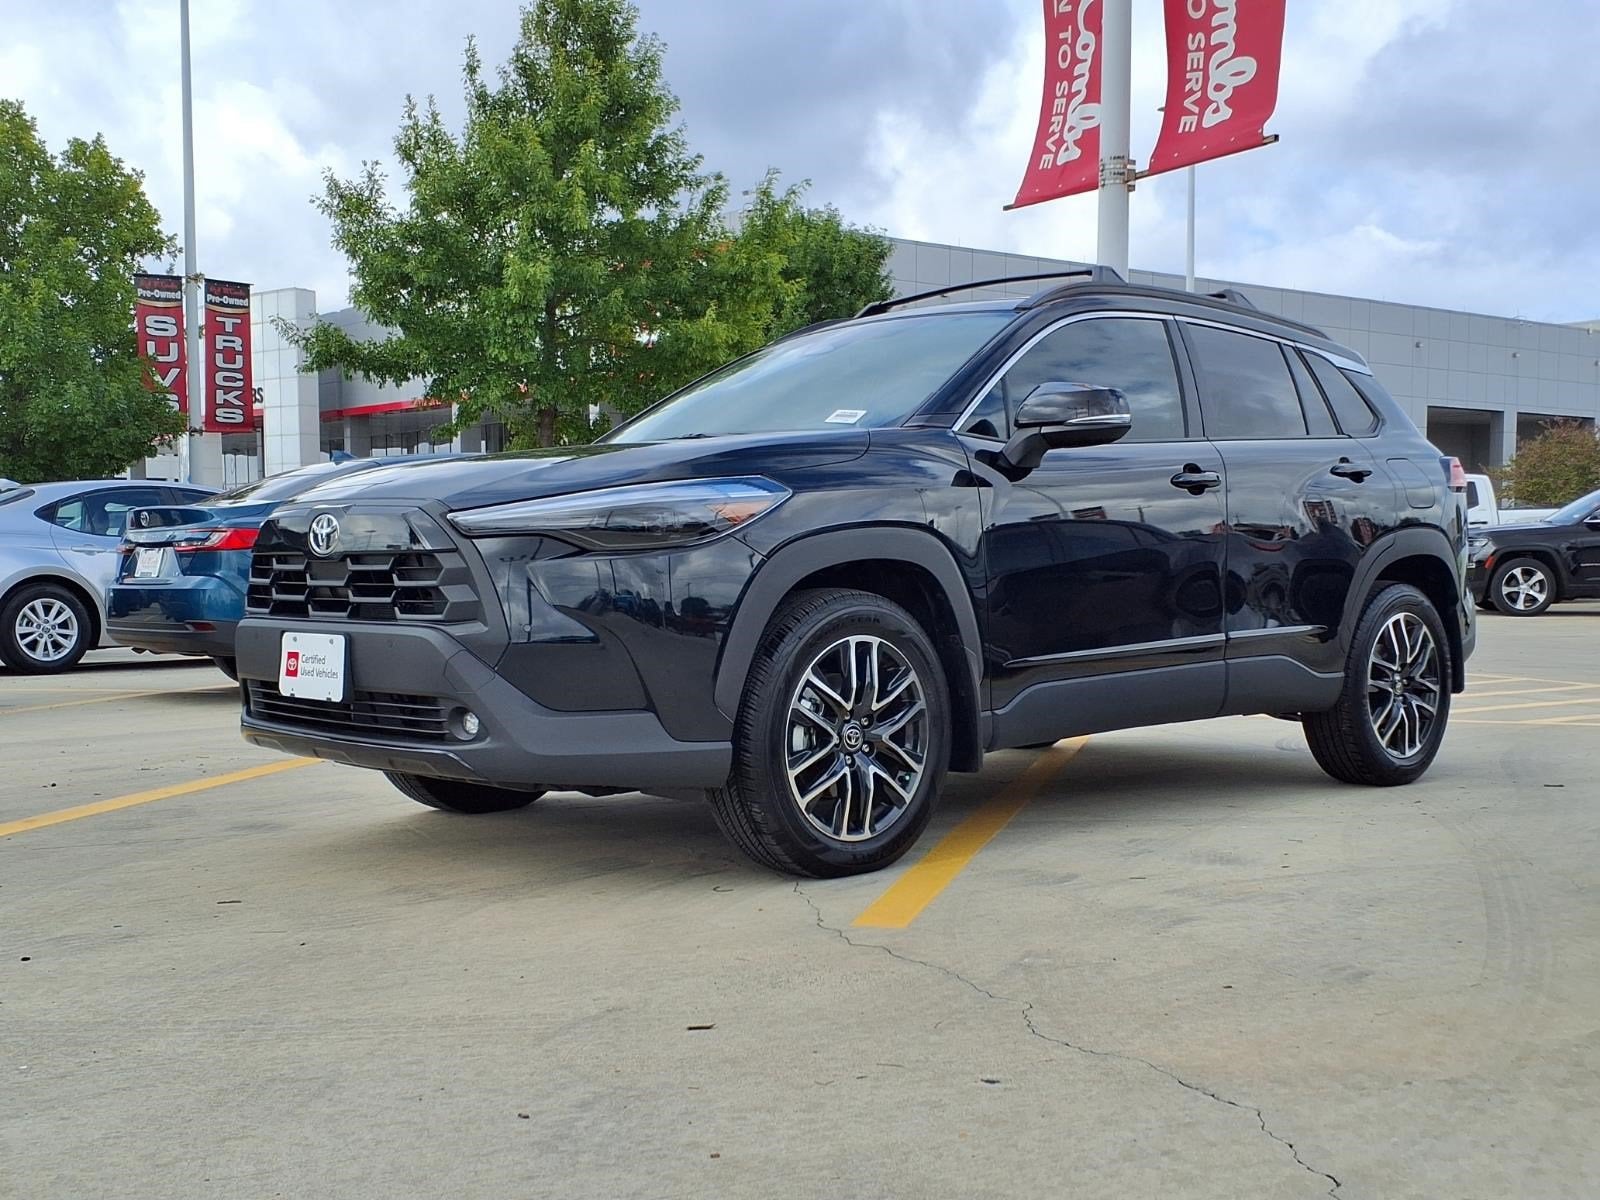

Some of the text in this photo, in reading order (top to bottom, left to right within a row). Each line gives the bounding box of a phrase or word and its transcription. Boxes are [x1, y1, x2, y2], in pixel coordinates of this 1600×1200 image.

[1058, 25, 1072, 69] TO
[1178, 31, 1206, 134] SERVE
[1039, 81, 1069, 170] SERVE
[137, 288, 182, 299] Pre-Owned
[206, 294, 249, 307] Pre-Owned
[215, 316, 245, 424] TRUCKS
[300, 666, 339, 679] Used Vehicles
[301, 654, 326, 665] Certified
